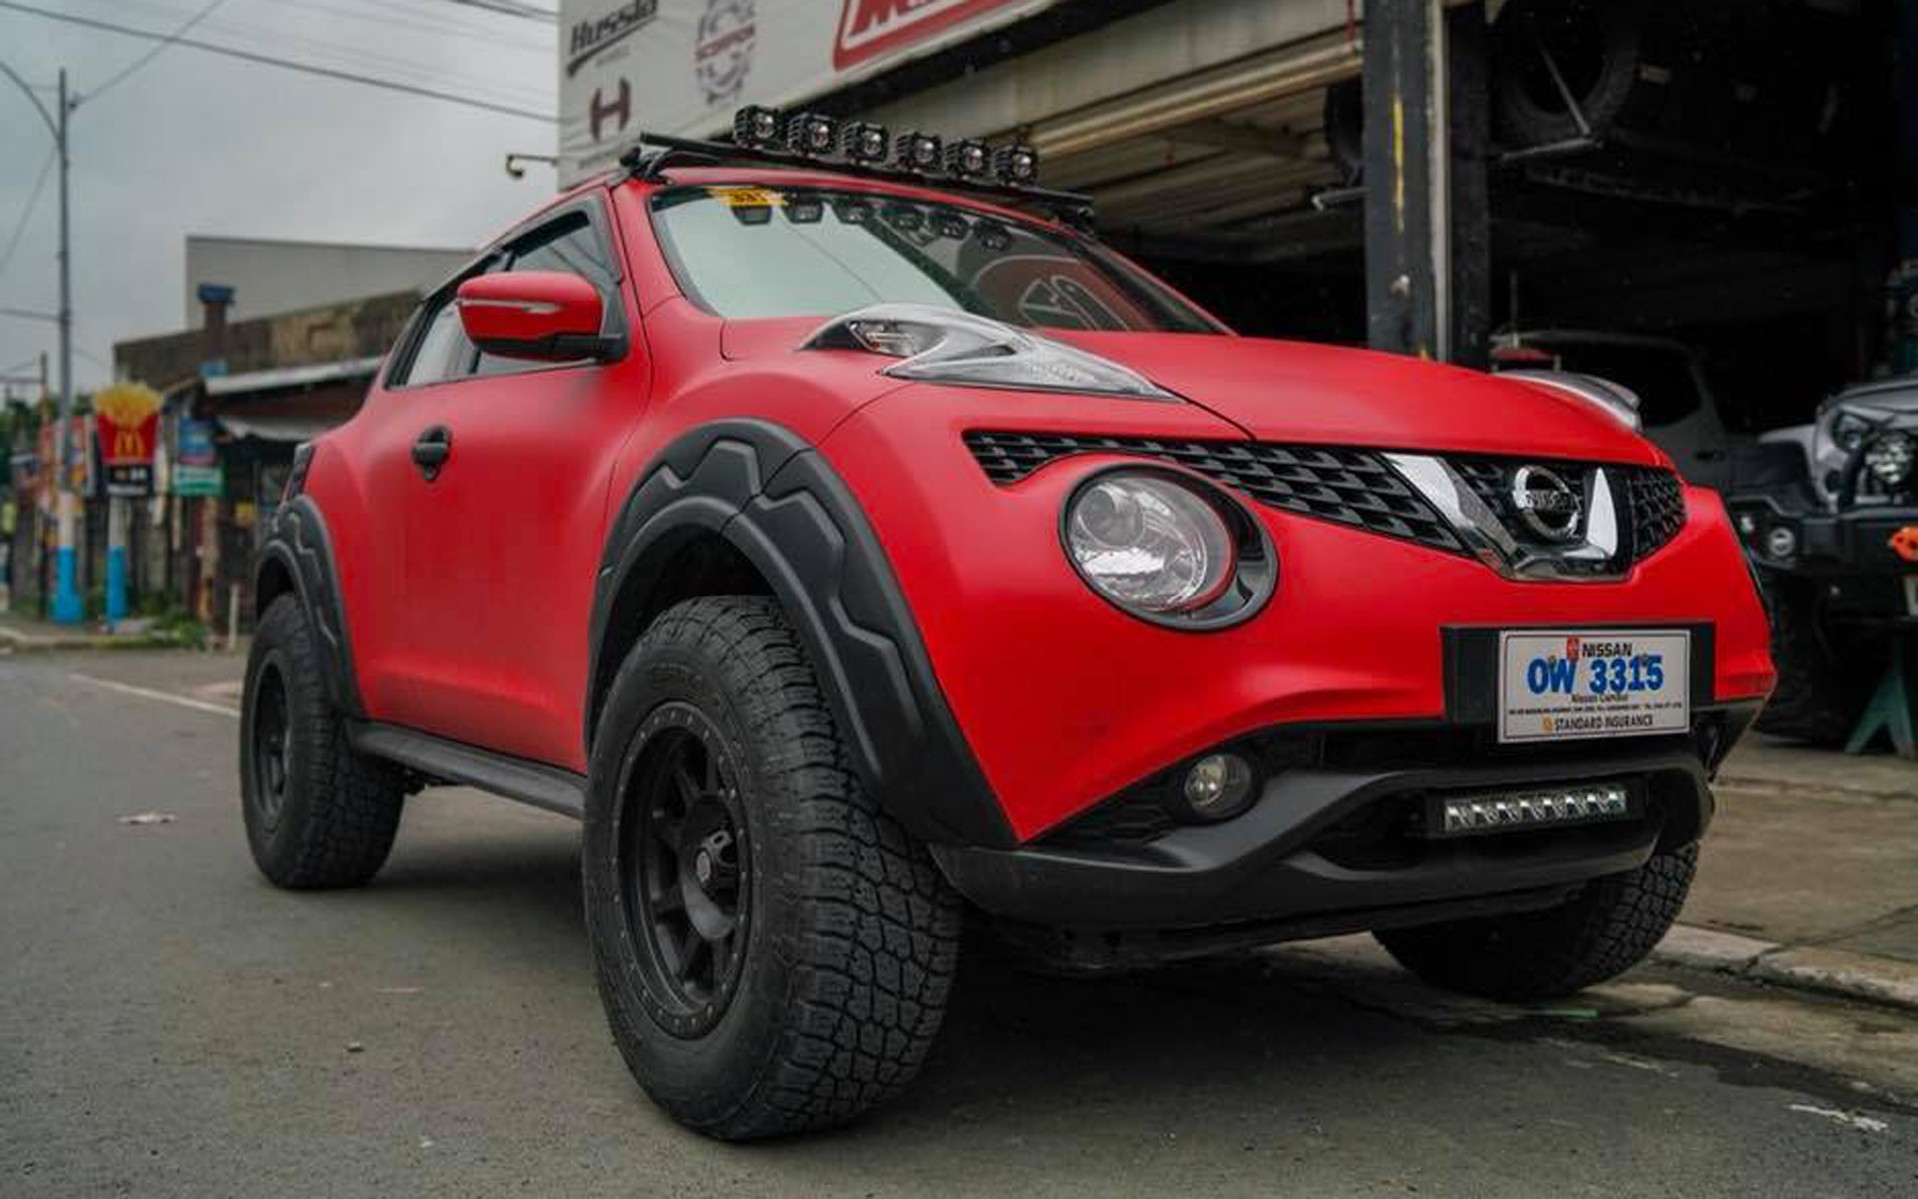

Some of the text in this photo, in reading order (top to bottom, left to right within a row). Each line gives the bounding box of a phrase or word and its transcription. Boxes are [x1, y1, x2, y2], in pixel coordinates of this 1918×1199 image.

[1582, 642, 1633, 657] NISSAN
[1527, 654, 1664, 694] OW 3315
[1555, 713, 1654, 731] STANDARD INSURANCE
